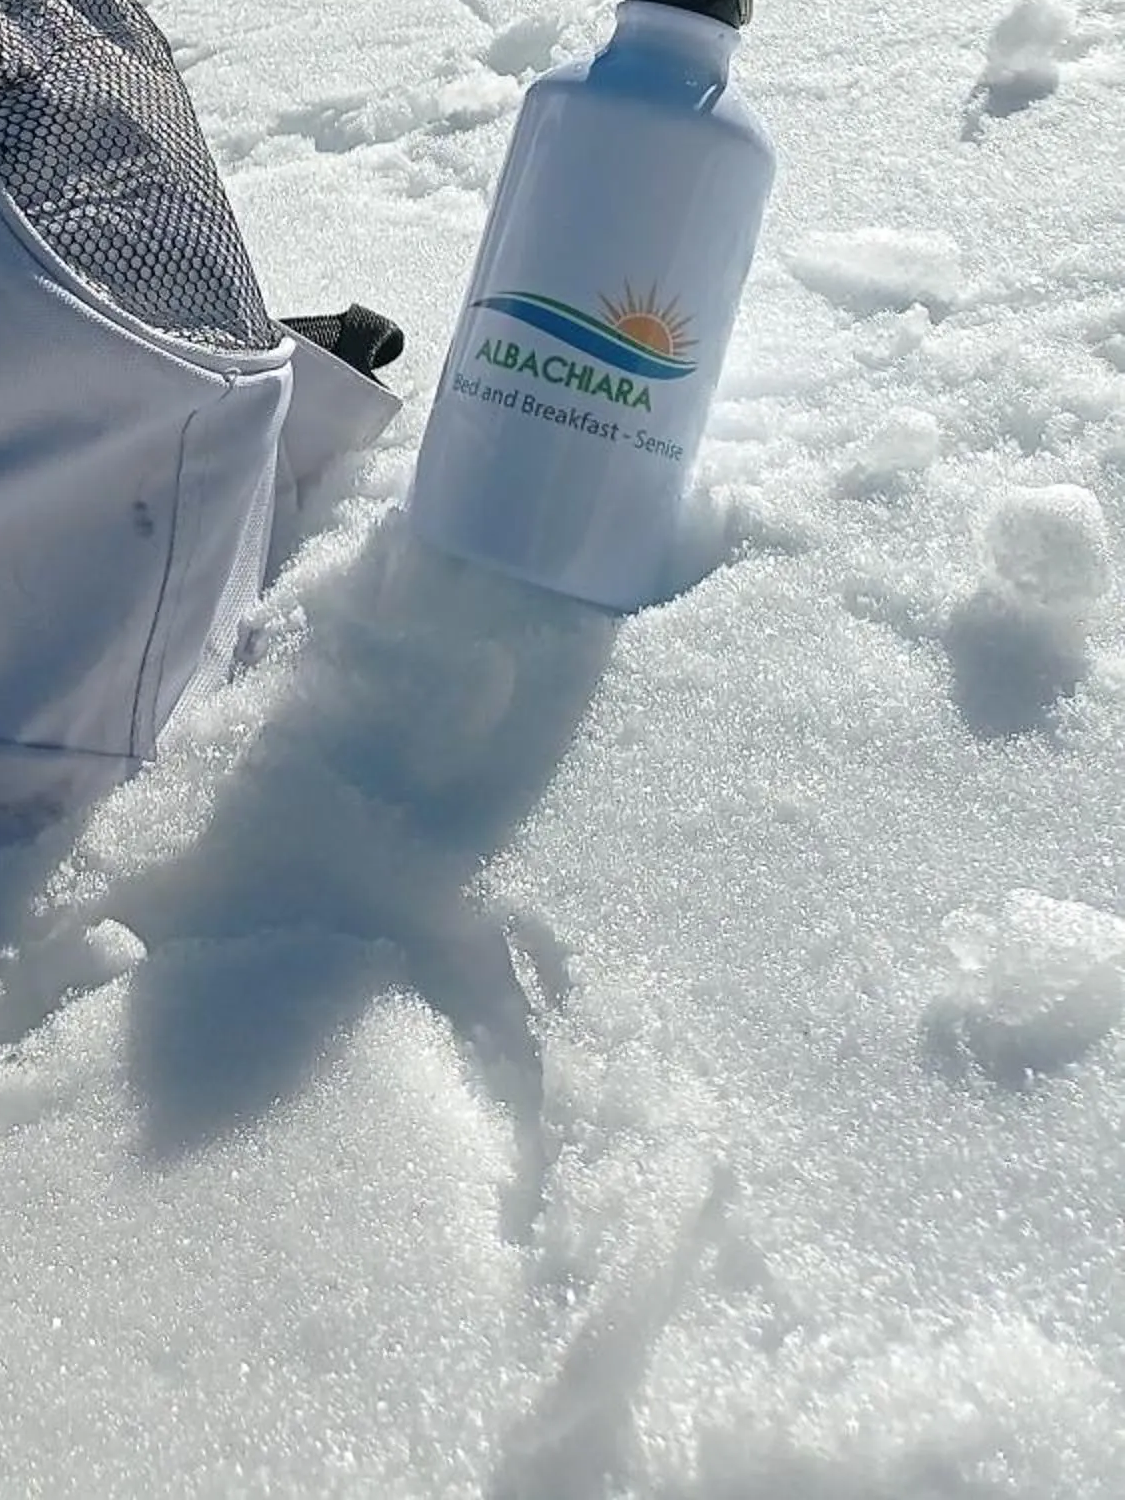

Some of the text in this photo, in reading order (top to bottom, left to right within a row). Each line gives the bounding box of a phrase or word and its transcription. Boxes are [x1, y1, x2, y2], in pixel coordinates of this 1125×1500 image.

[477, 339, 652, 412] ALBACHIARA
[453, 373, 480, 397] Bed
[483, 384, 519, 408] and
[522, 394, 620, 441] Breakfast
[635, 430, 684, 461] Senise
